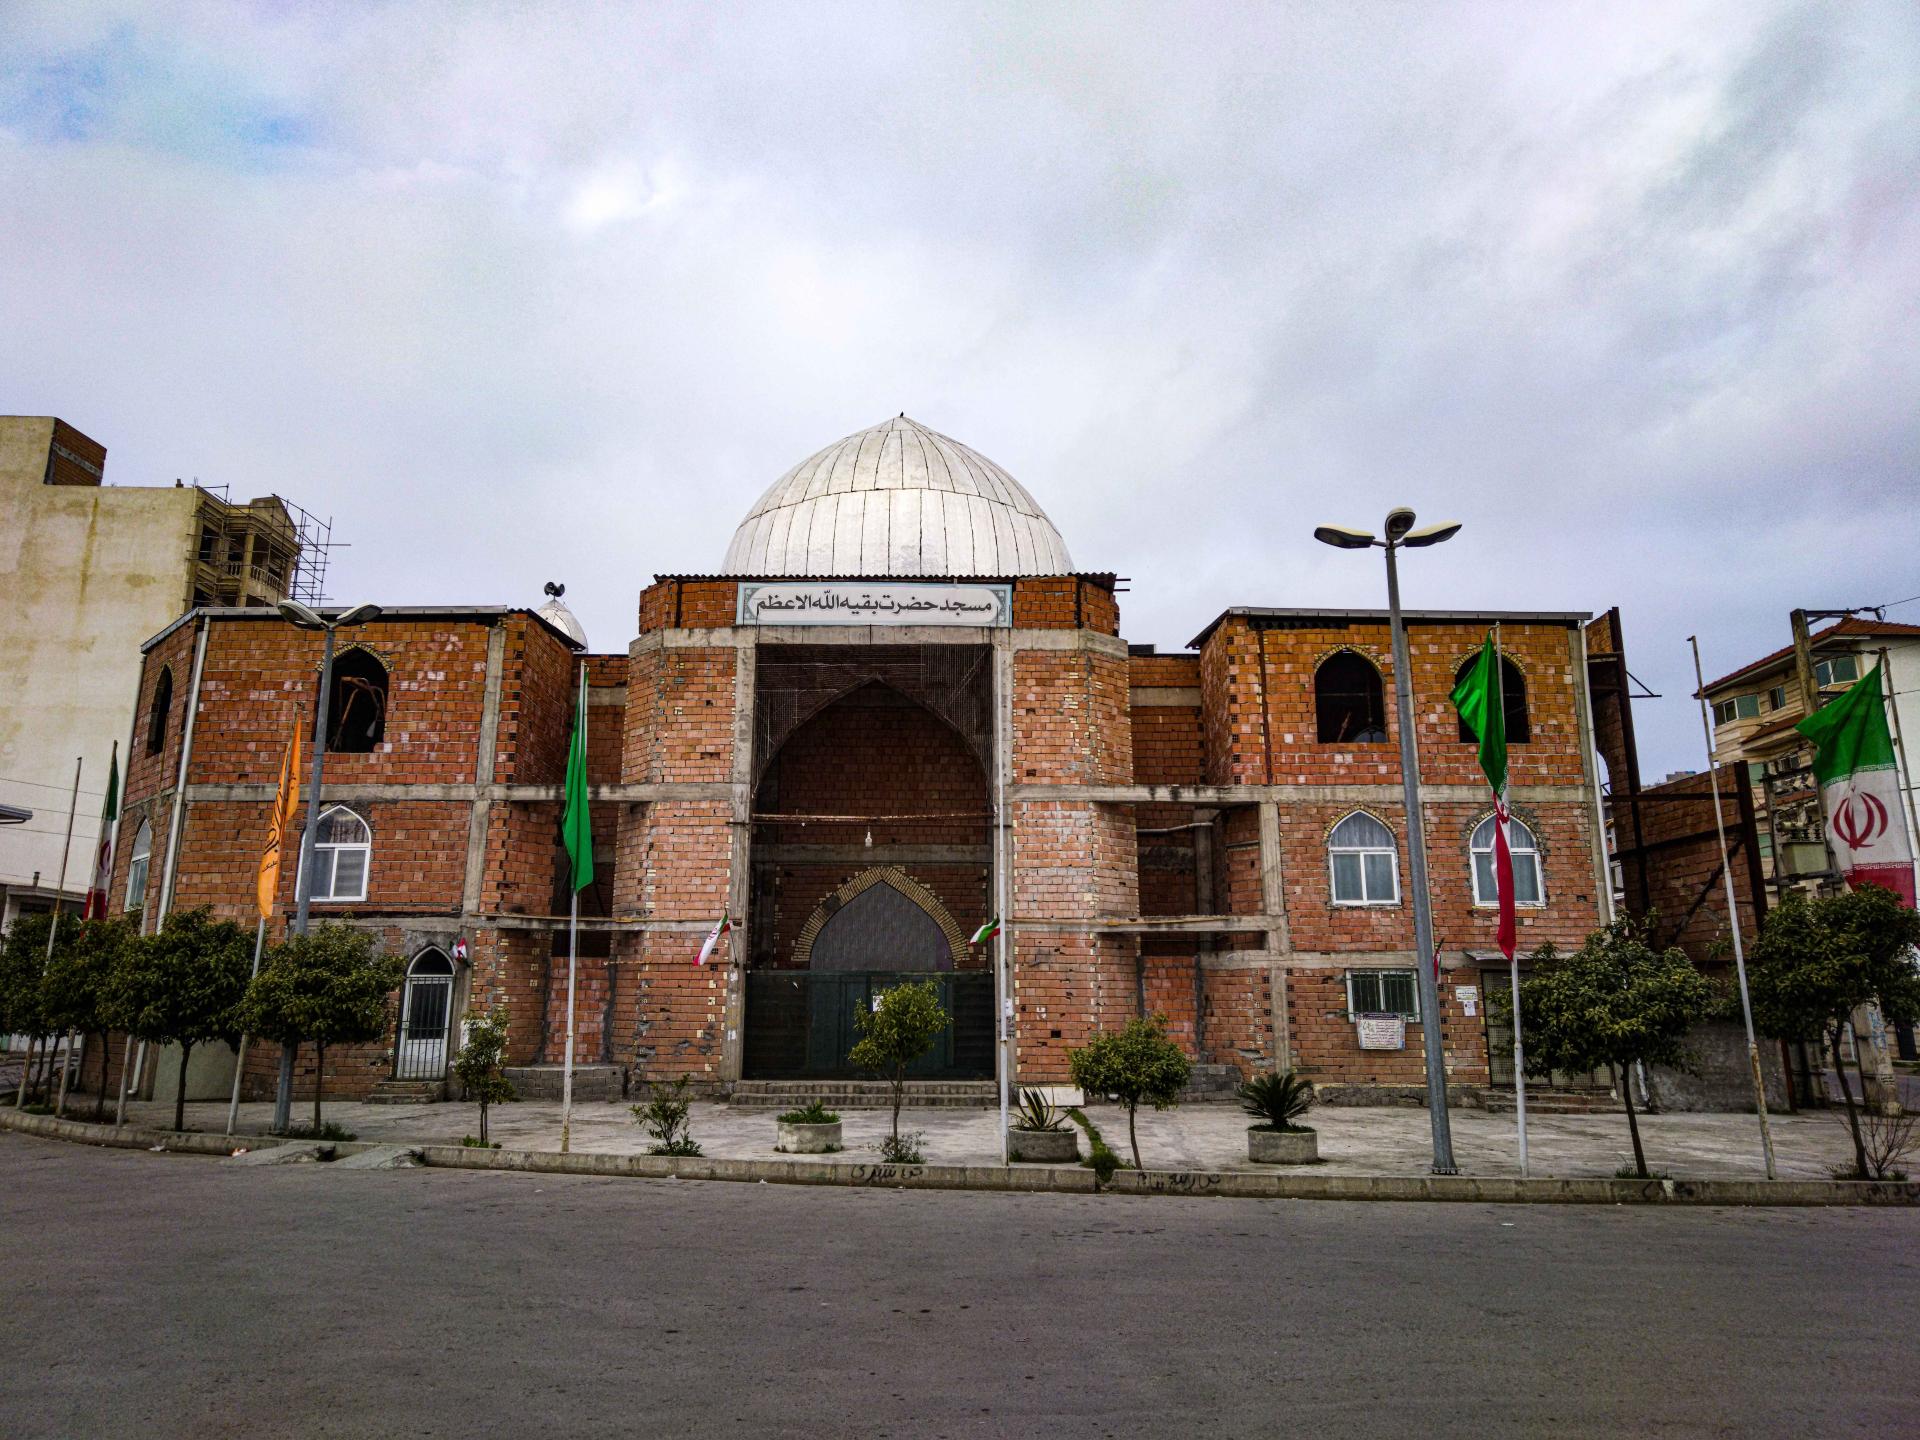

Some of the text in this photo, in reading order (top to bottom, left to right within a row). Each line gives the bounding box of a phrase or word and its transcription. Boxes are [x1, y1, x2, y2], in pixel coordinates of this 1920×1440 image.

[756, 594, 812, 617] الاعظم
[879, 594, 939, 615] حضرت
[939, 599, 992, 616] مسجد
